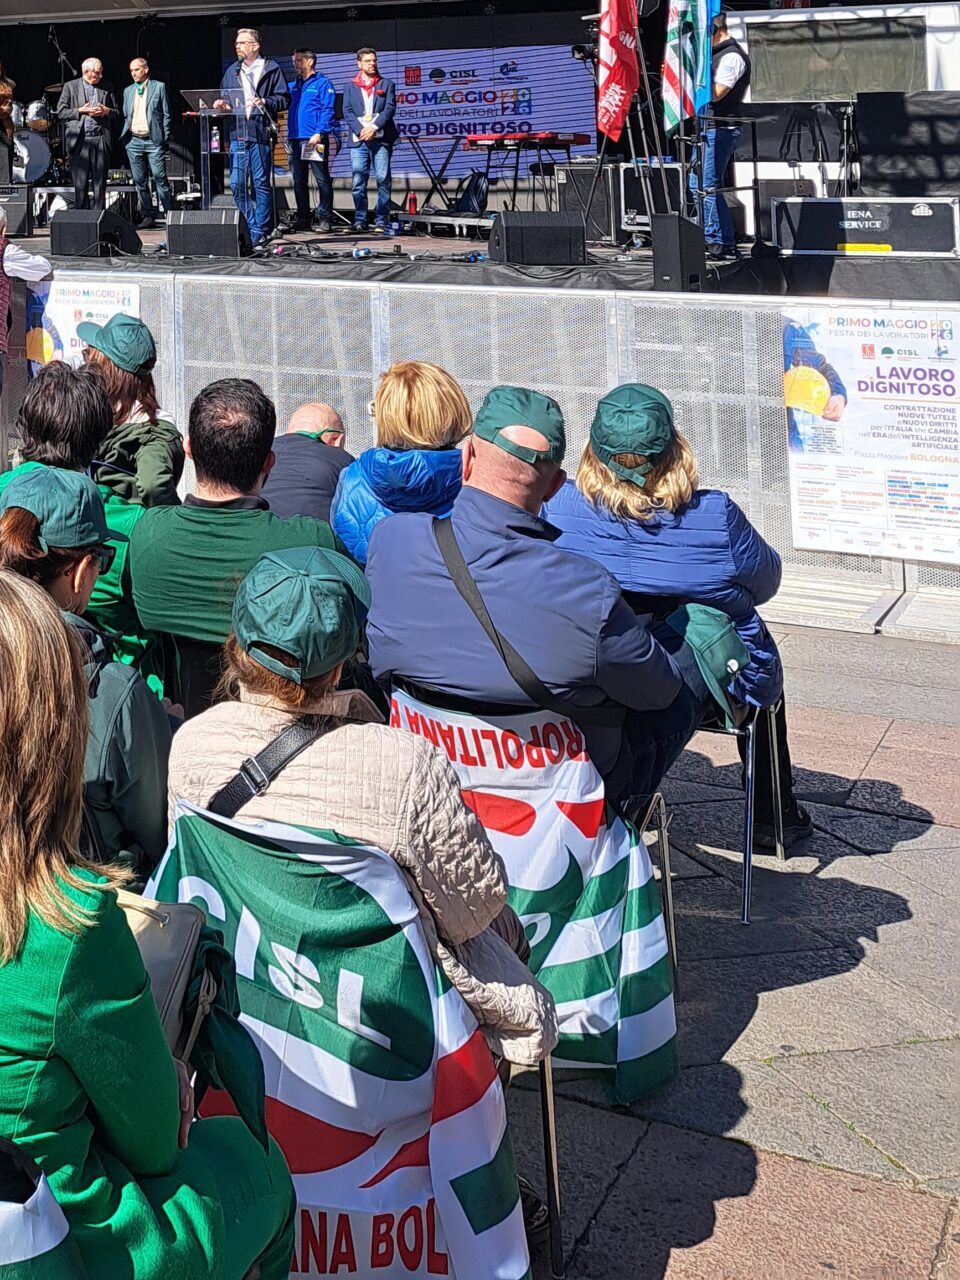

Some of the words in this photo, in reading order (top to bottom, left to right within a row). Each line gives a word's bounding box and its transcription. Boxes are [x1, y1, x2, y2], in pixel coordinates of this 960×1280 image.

[450, 69, 479, 78] CISL
[423, 90, 498, 105] MAGGIO
[426, 120, 532, 136] DIGNITOSO
[847, 210, 873, 219] IENA
[839, 220, 882, 229] SERVICE
[828, 316, 871, 328] PRIMO
[873, 318, 928, 330] MAGGIO
[828, 329, 855, 337] FESTA
[857, 330, 871, 338] DEI
[873, 330, 928, 339] LAVORATORI
[897, 348, 919, 356] CISL
[876, 366, 955, 382] LAVORO
[857, 380, 956, 397] DIGNITOSO
[883, 404, 957, 414] CONTRATTAZIONE
[898, 412, 926, 420] NUOVE
[927, 413, 957, 422] TUTELE
[903, 419, 928, 427] NUOVI
[929, 420, 958, 428] DIRITTI
[928, 428, 959, 436] CAMBIA
[911, 442, 959, 451] ARTIFICIALE
[910, 453, 960, 464] BOLOGNA
